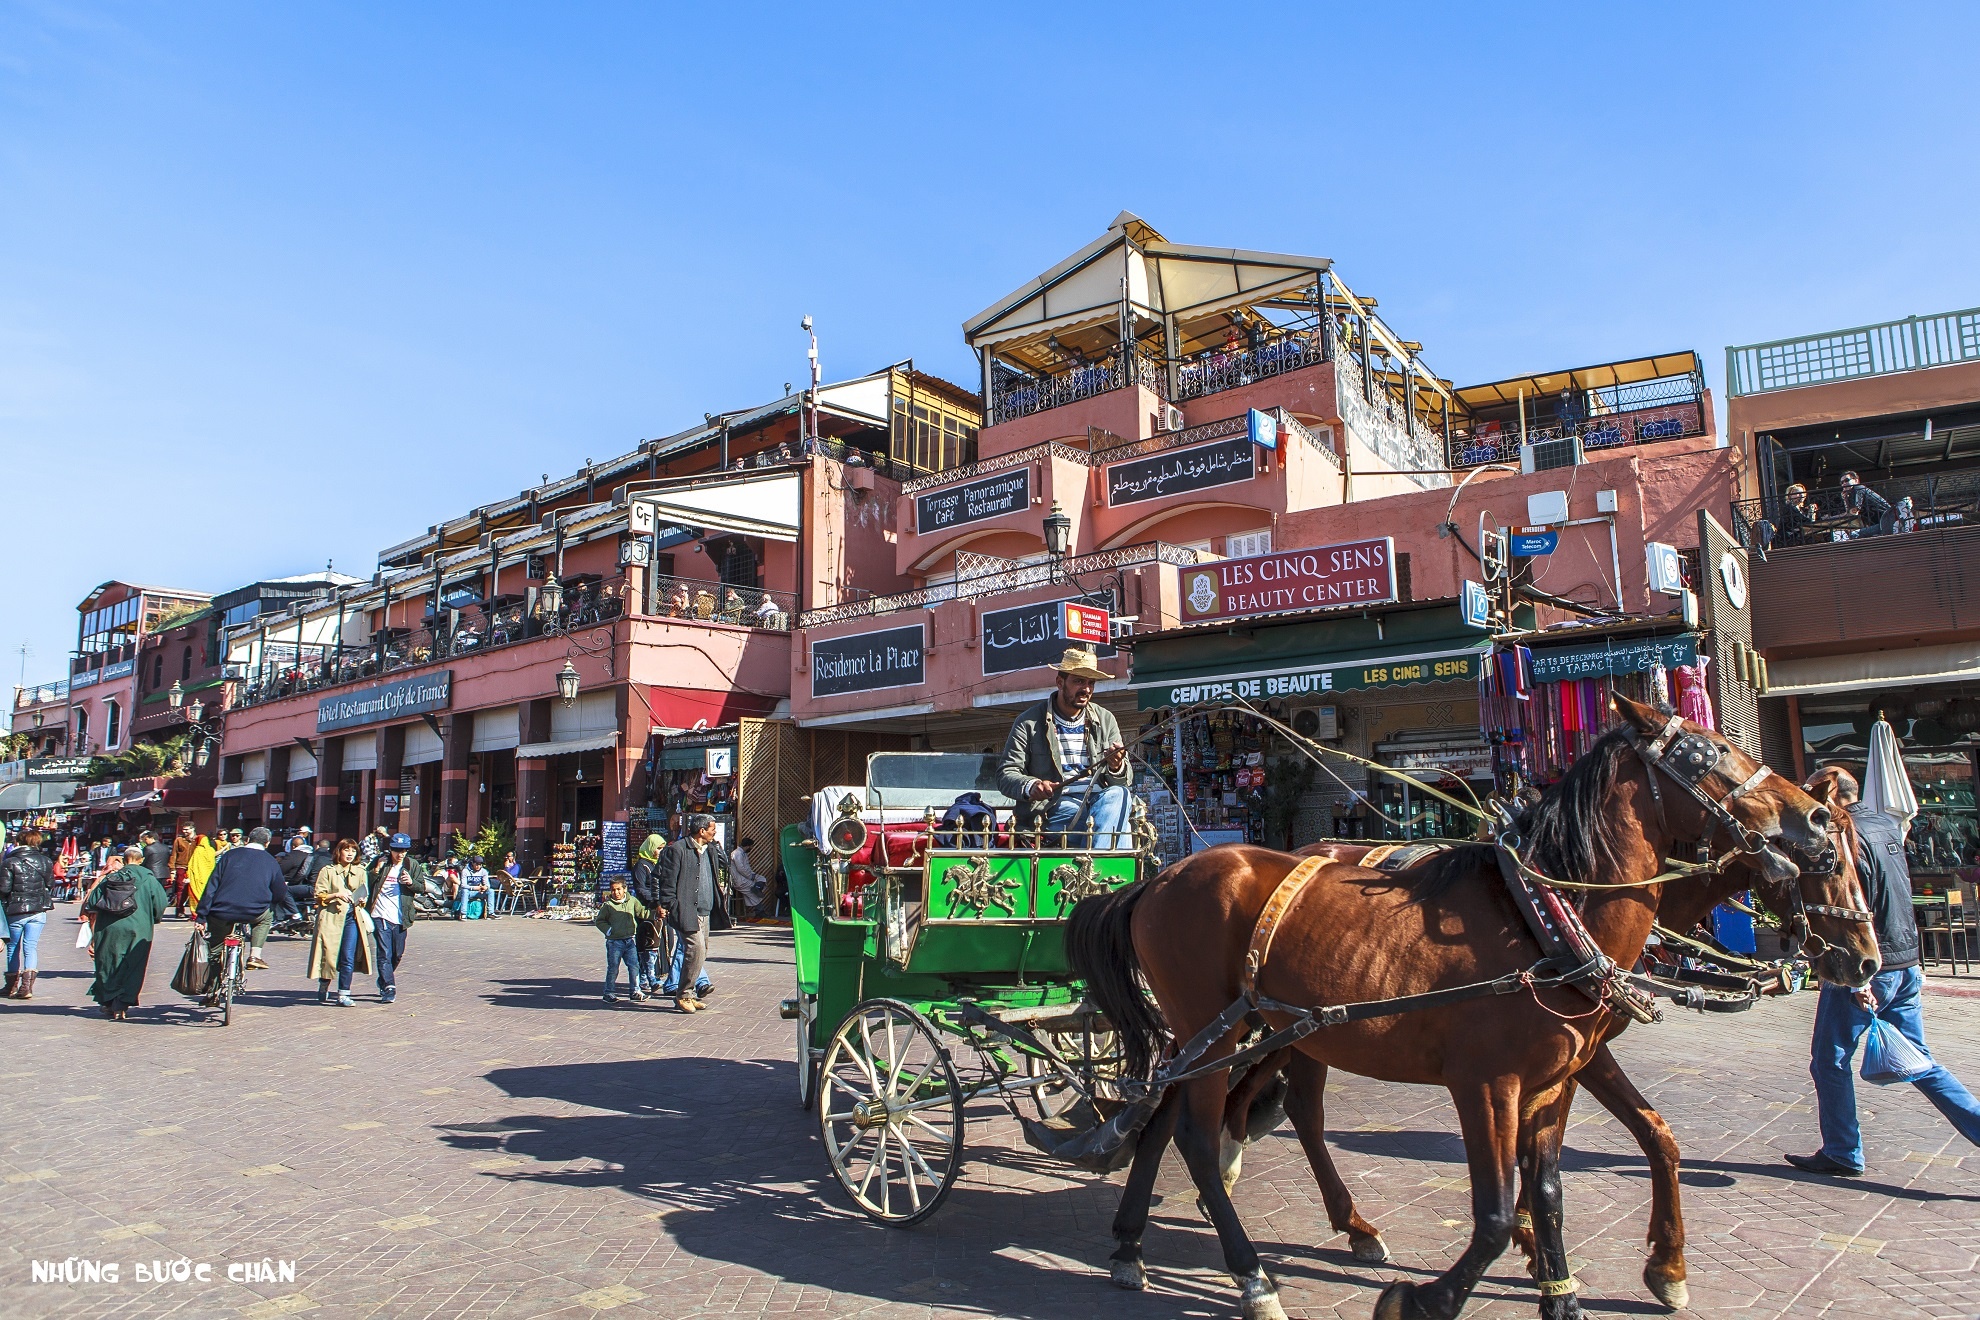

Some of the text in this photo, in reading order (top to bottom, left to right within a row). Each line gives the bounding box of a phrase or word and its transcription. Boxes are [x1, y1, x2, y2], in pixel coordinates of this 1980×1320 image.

[1156, 460, 1183, 493] السطح
[1183, 458, 1205, 477] فوق
[1206, 453, 1227, 473] شامل
[1227, 450, 1252, 471] منظر
[925, 477, 1024, 513] Terrasse Panoramique
[935, 493, 1014, 525] Café Restaurant
[1521, 525, 1547, 534] REVENDEUR
[1221, 545, 1385, 587] LES CINQ SENS
[1227, 577, 1381, 612] BEAUTY CENTER
[815, 646, 919, 681] Residence La Place
[1364, 668, 1388, 684] LES
[1434, 660, 1468, 677] SENS
[1550, 665, 1561, 673] DE
[1566, 660, 1605, 674] TABAC
[317, 683, 448, 724] Hôtel Restaurant Café de France
[1170, 672, 1333, 704] CENTRE DE BEAUTE
[28, 766, 70, 776] Restaurant
